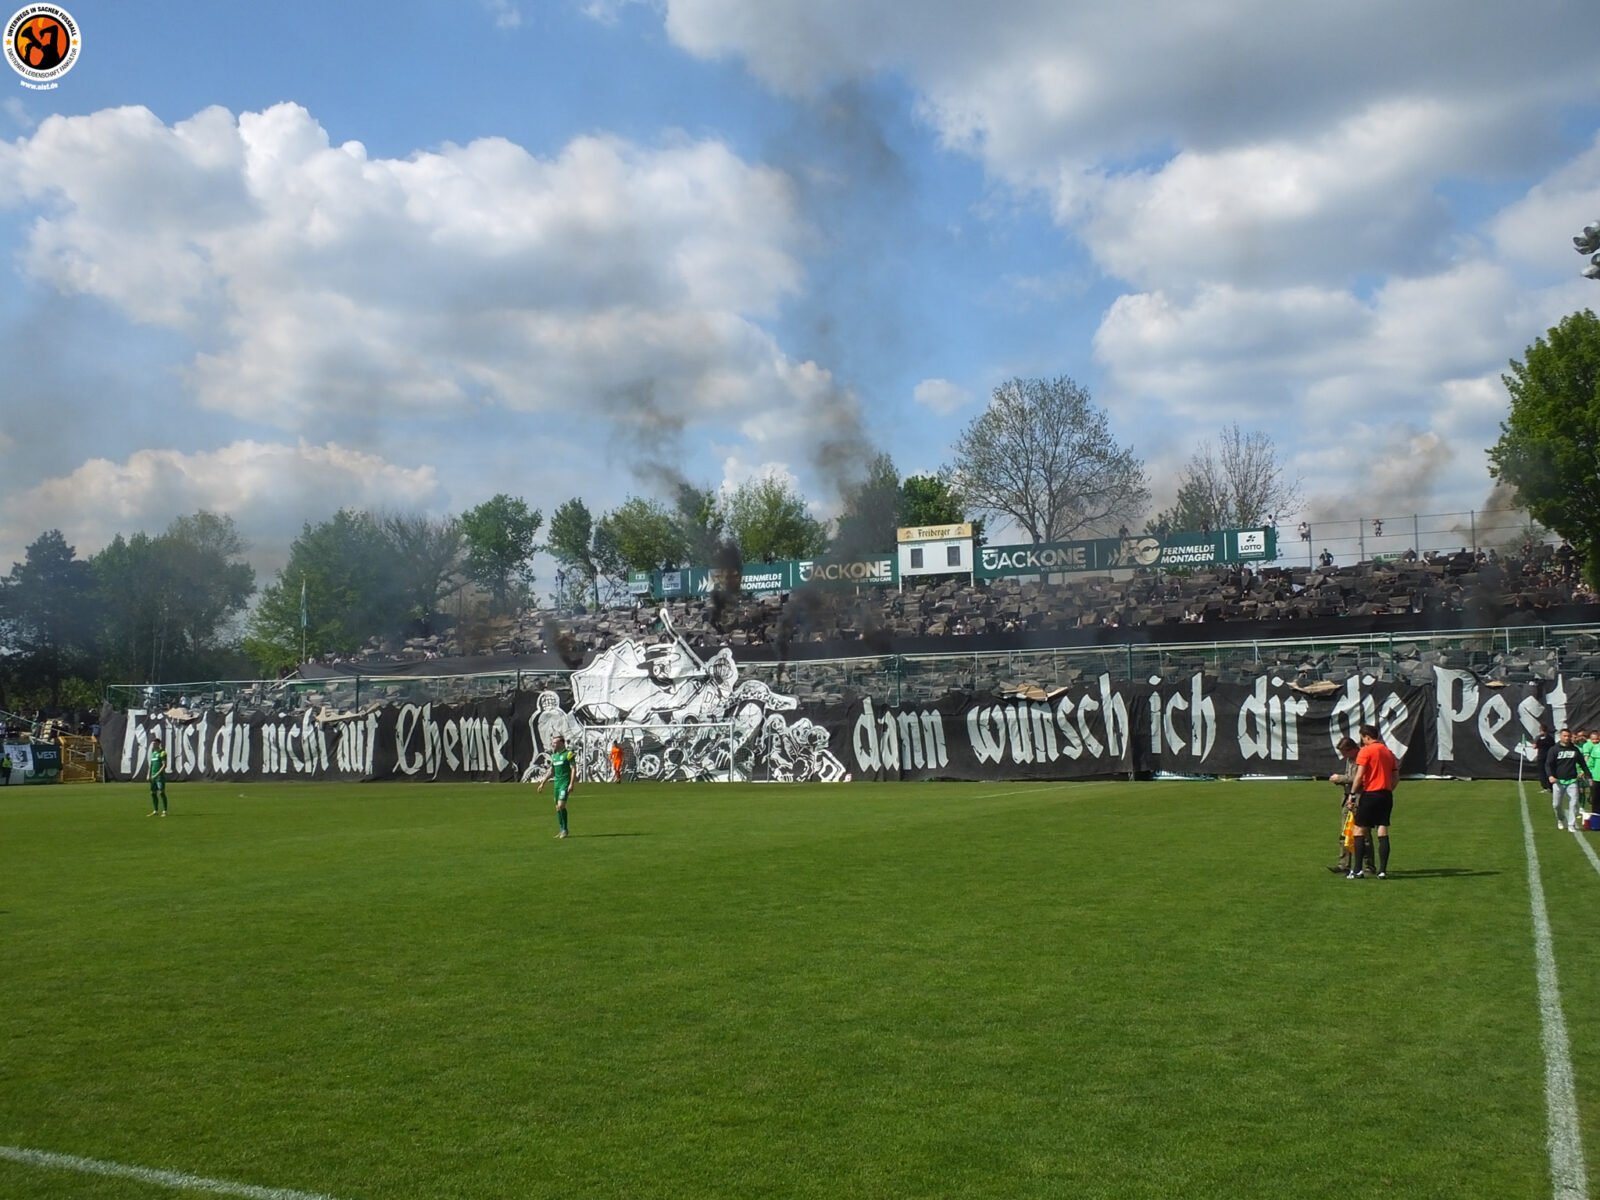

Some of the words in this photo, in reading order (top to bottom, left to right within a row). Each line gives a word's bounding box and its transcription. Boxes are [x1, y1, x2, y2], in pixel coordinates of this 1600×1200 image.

[917, 528, 951, 539] Freiberger
[1162, 544, 1216, 555] FERNMELDE
[1160, 553, 1215, 564] MONTAGEN
[741, 573, 782, 583] FERNMELDE
[740, 581, 781, 590] MONTAGEN
[853, 696, 949, 772] dann
[1149, 671, 1217, 764] ich
[1238, 675, 1309, 761] dir
[1329, 674, 1409, 760] die
[1433, 665, 1568, 763] Pest
[212, 710, 250, 774] du
[261, 708, 329, 777] nicht
[337, 710, 382, 775] auf
[36, 751, 57, 759] WEST
